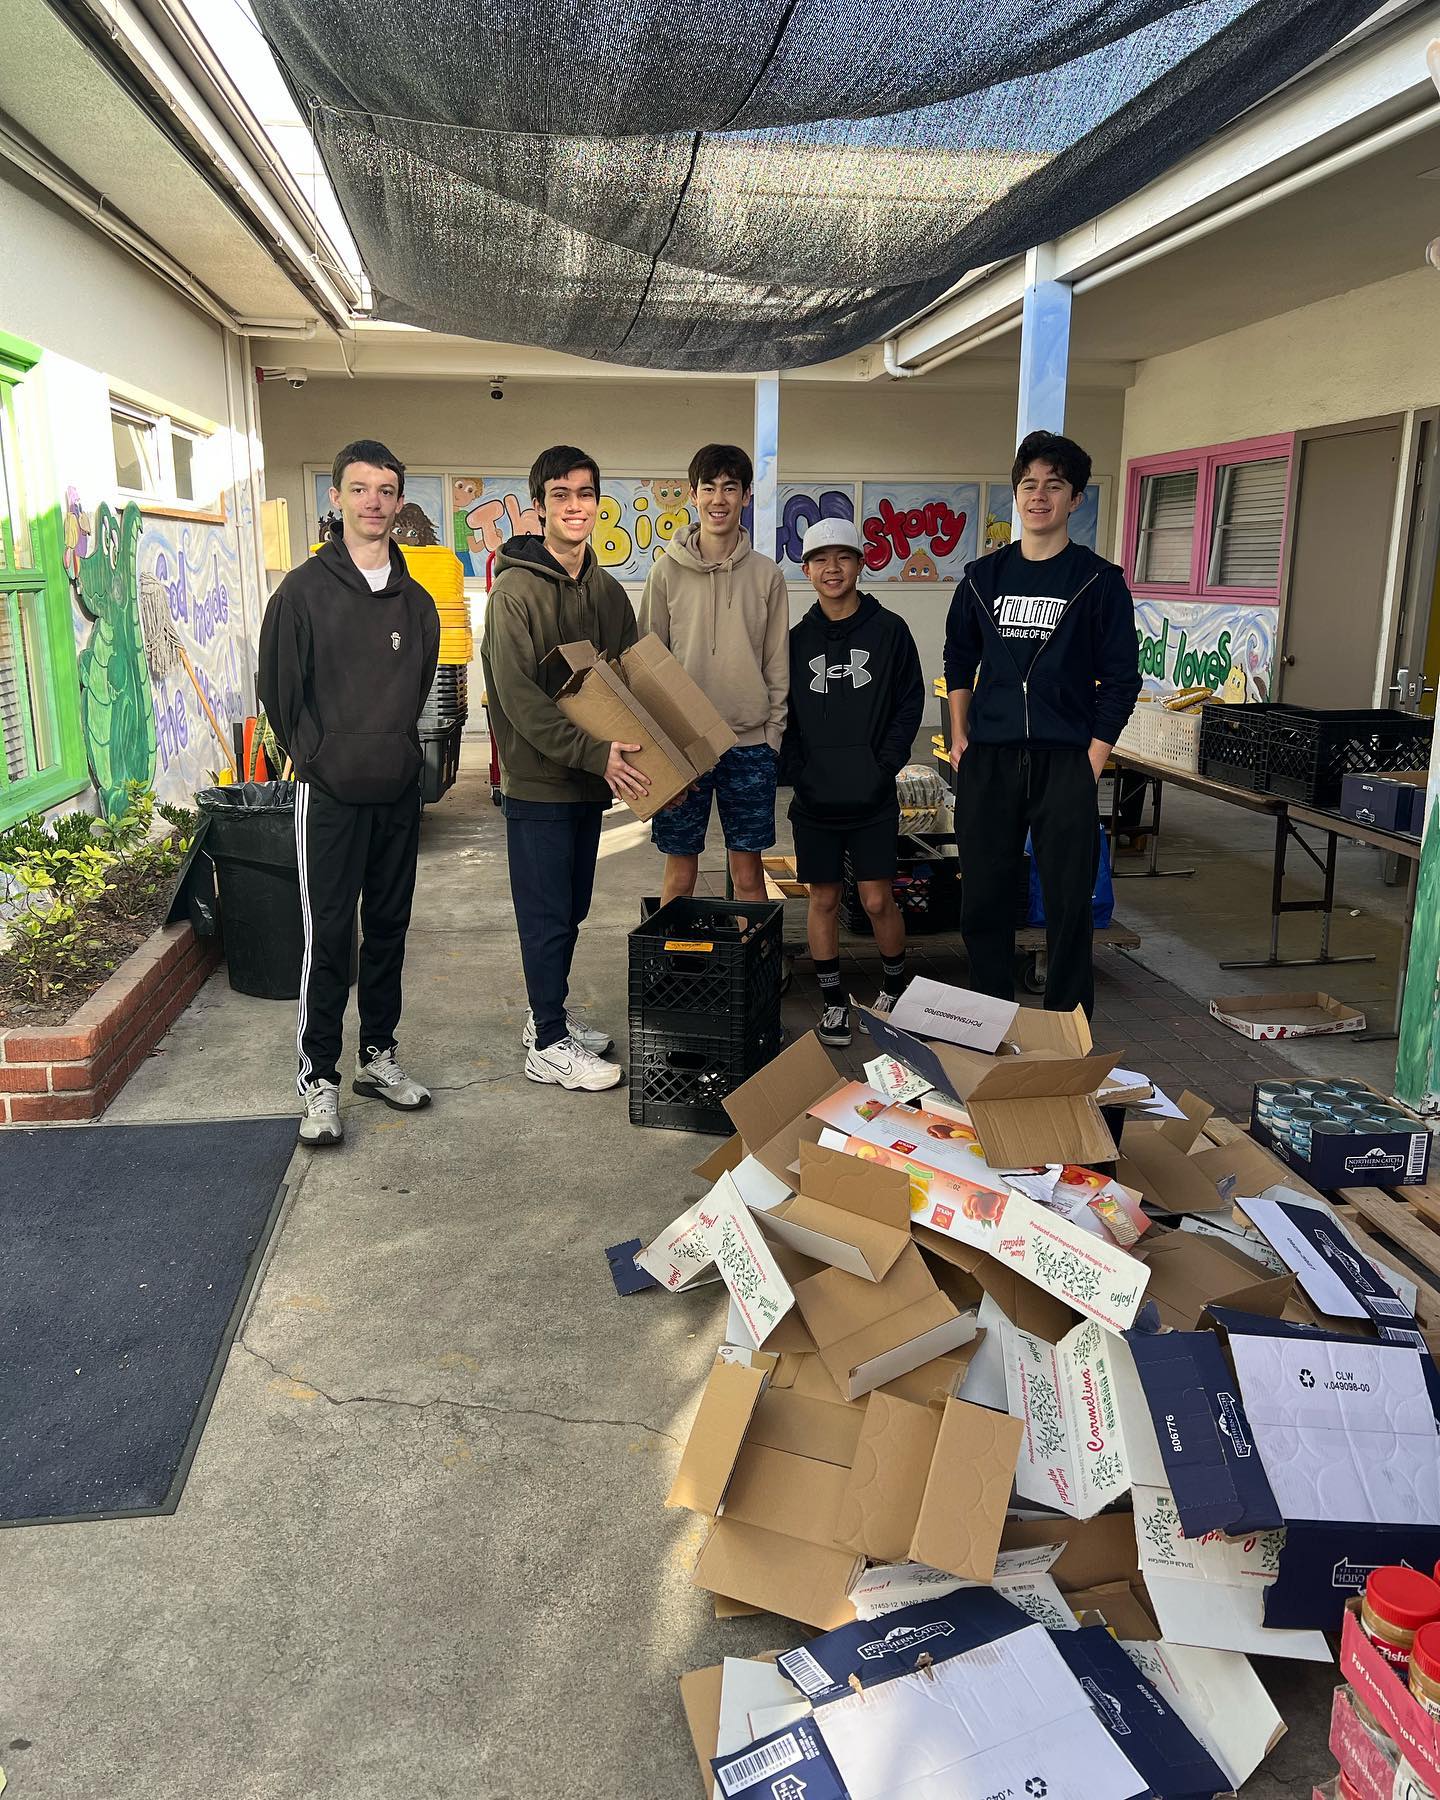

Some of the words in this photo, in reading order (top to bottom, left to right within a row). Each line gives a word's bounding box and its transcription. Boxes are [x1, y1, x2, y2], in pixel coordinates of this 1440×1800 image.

[465, 494, 545, 552] Th
[1002, 628, 1028, 639] LEAGUE
[1029, 629, 1040, 639] OF
[1173, 630, 1231, 690] loves
[1029, 1221, 1050, 1237] Produced
[1050, 1233, 1059, 1241] and
[1059, 1238, 1078, 1254] Imported
[1110, 1286, 1138, 1307] enjoy!
[1017, 1334, 1042, 1363] enjoy!
[1324, 1381, 1370, 1392] v.049098-00
[1335, 1371, 1354, 1381] CLW
[1081, 1368, 1104, 1452] Carmelina
[1165, 1414, 1183, 1452] 806776
[1048, 1469, 1075, 1507] appetito!
[1055, 1467, 1069, 1489] buon
[1338, 1574, 1365, 1583] CATCH
[870, 1602, 899, 1610] 57453-12
[1376, 1645, 1409, 1663] Fishe
[1136, 1684, 1166, 1716] 806776
[1352, 1652, 1365, 1674] For
[1399, 1725, 1416, 1746] you
[1417, 1744, 1434, 1766] can
